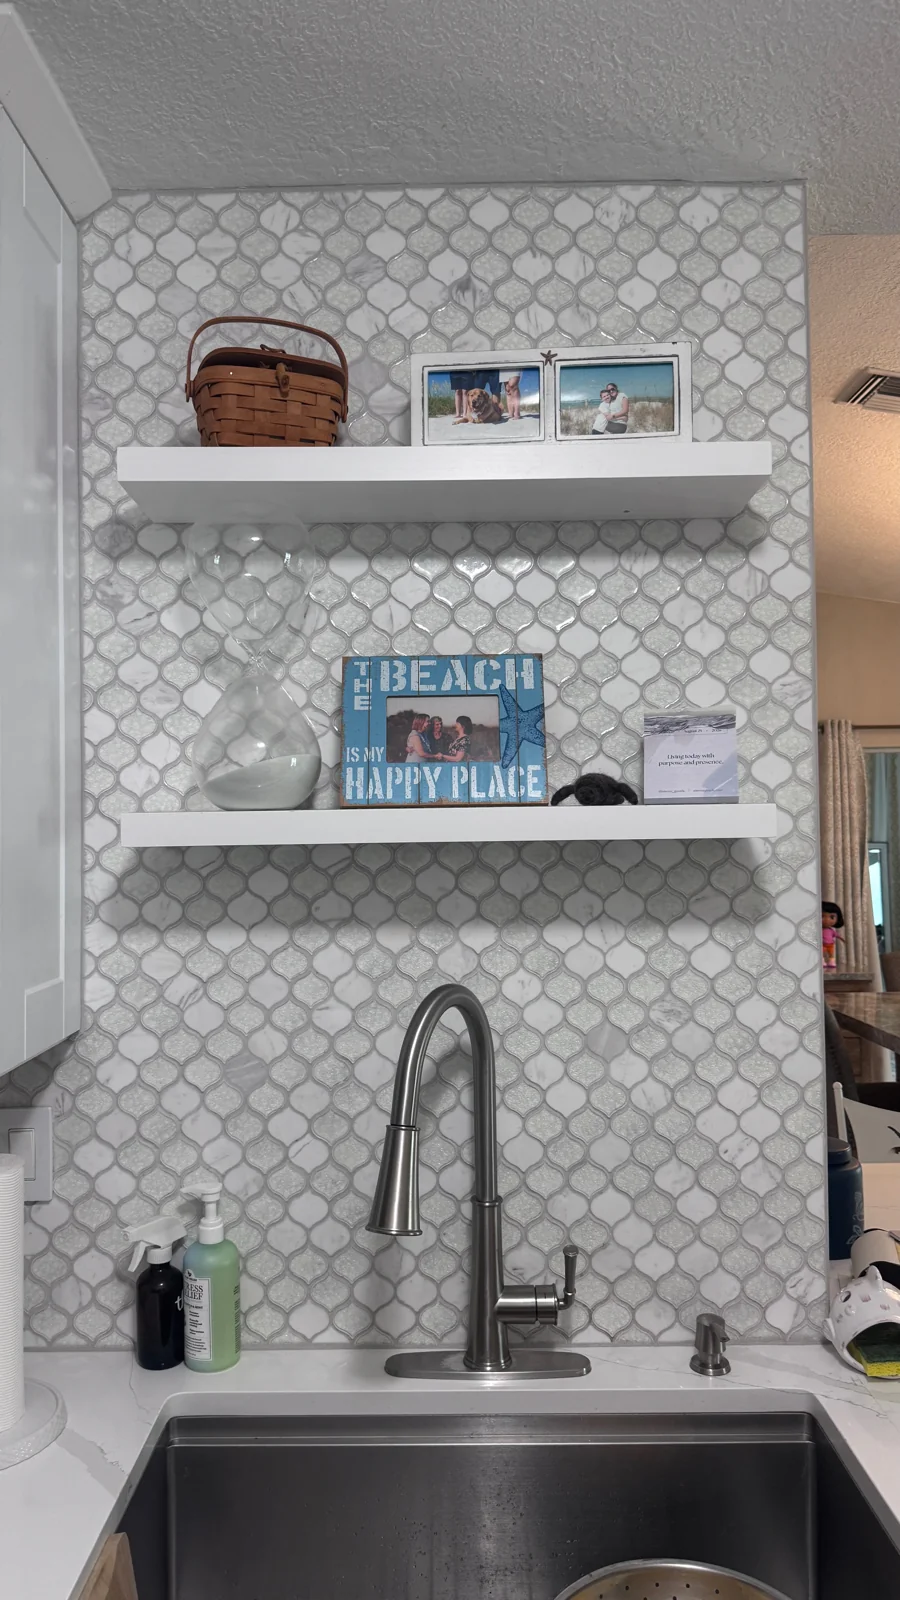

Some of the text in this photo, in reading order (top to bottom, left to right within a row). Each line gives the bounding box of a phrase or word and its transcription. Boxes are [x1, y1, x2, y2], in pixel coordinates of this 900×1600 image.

[354, 661, 372, 710] THE
[380, 658, 535, 691] BEACH
[346, 746, 384, 762] IS MY
[345, 765, 543, 800] HAPPY PLACE
